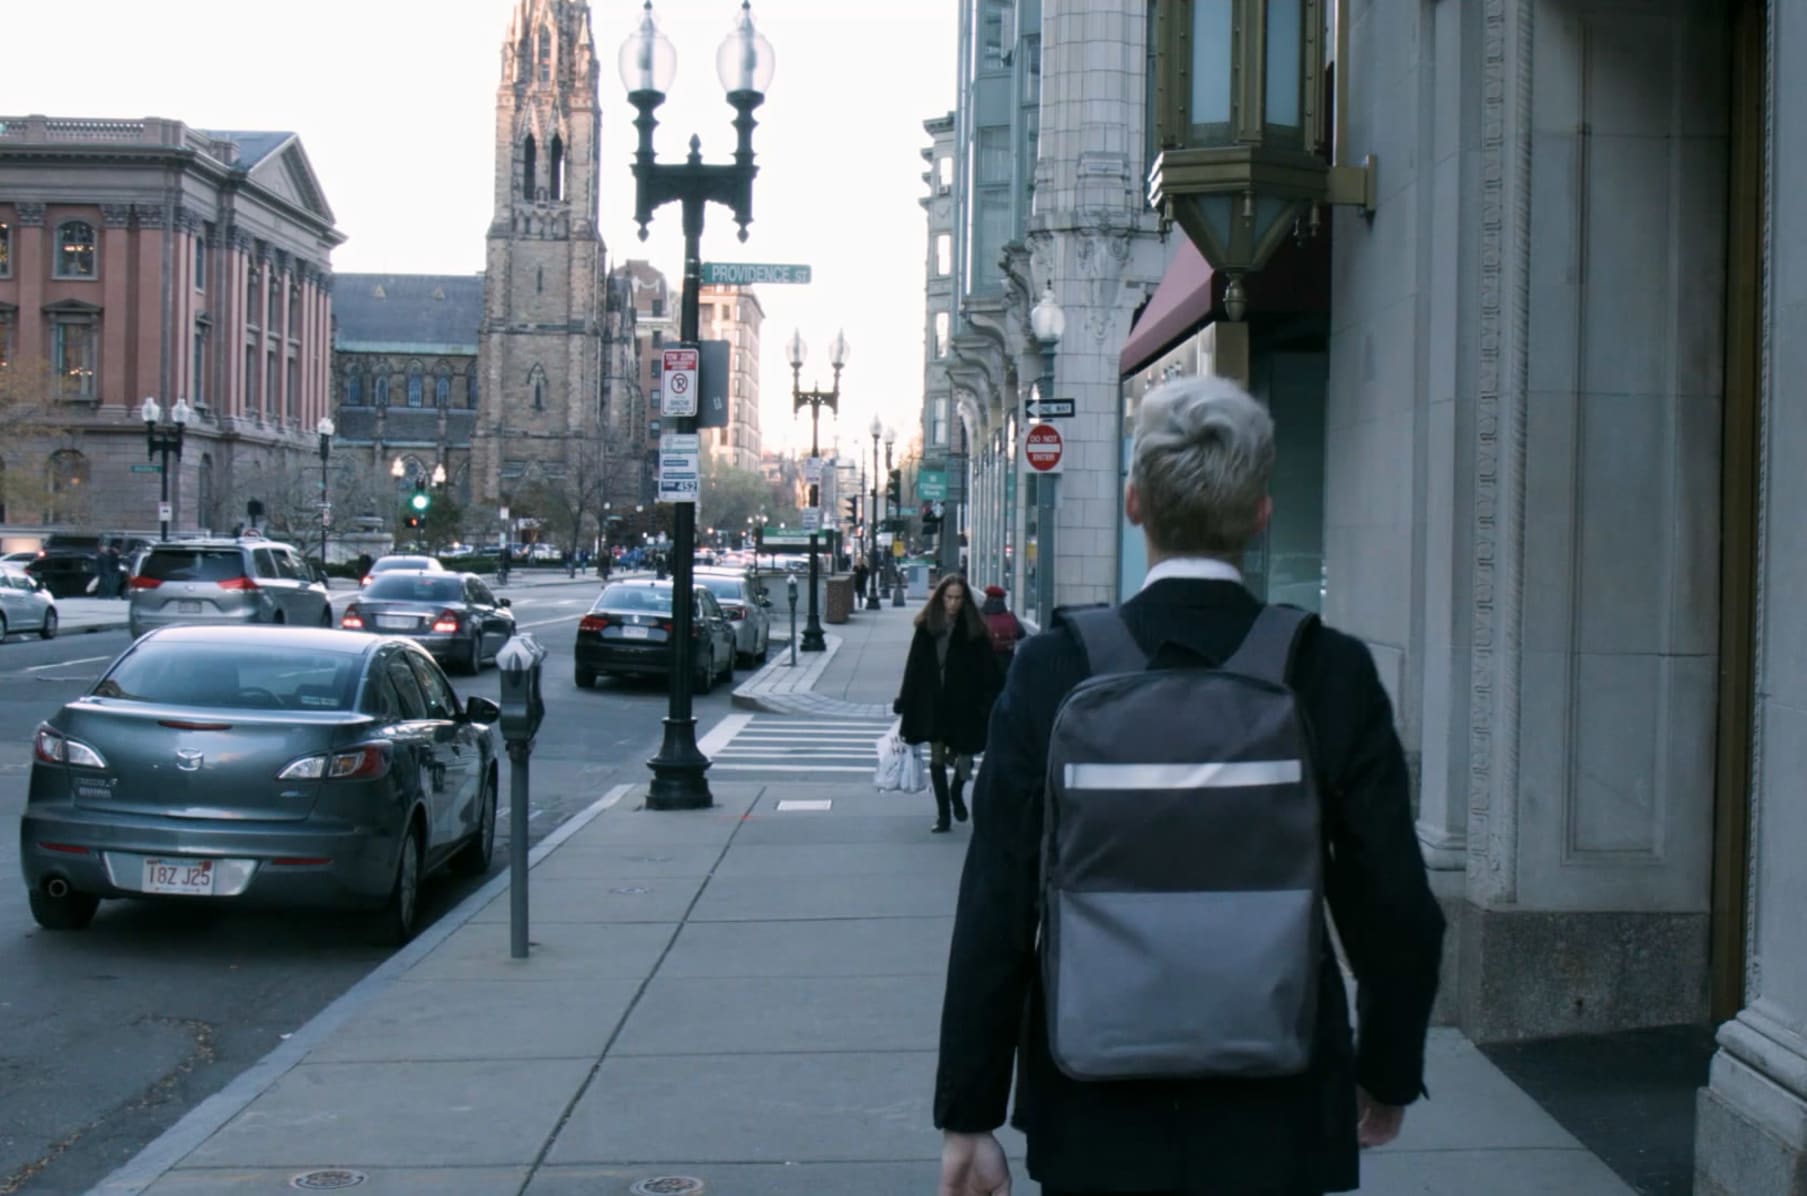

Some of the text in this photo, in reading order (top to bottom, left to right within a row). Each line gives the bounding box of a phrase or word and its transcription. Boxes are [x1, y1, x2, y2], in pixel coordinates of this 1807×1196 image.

[711, 265, 807, 283] PROVIDENCE ST
[1032, 453, 1056, 461] ENTER
[181, 868, 211, 886] J25
